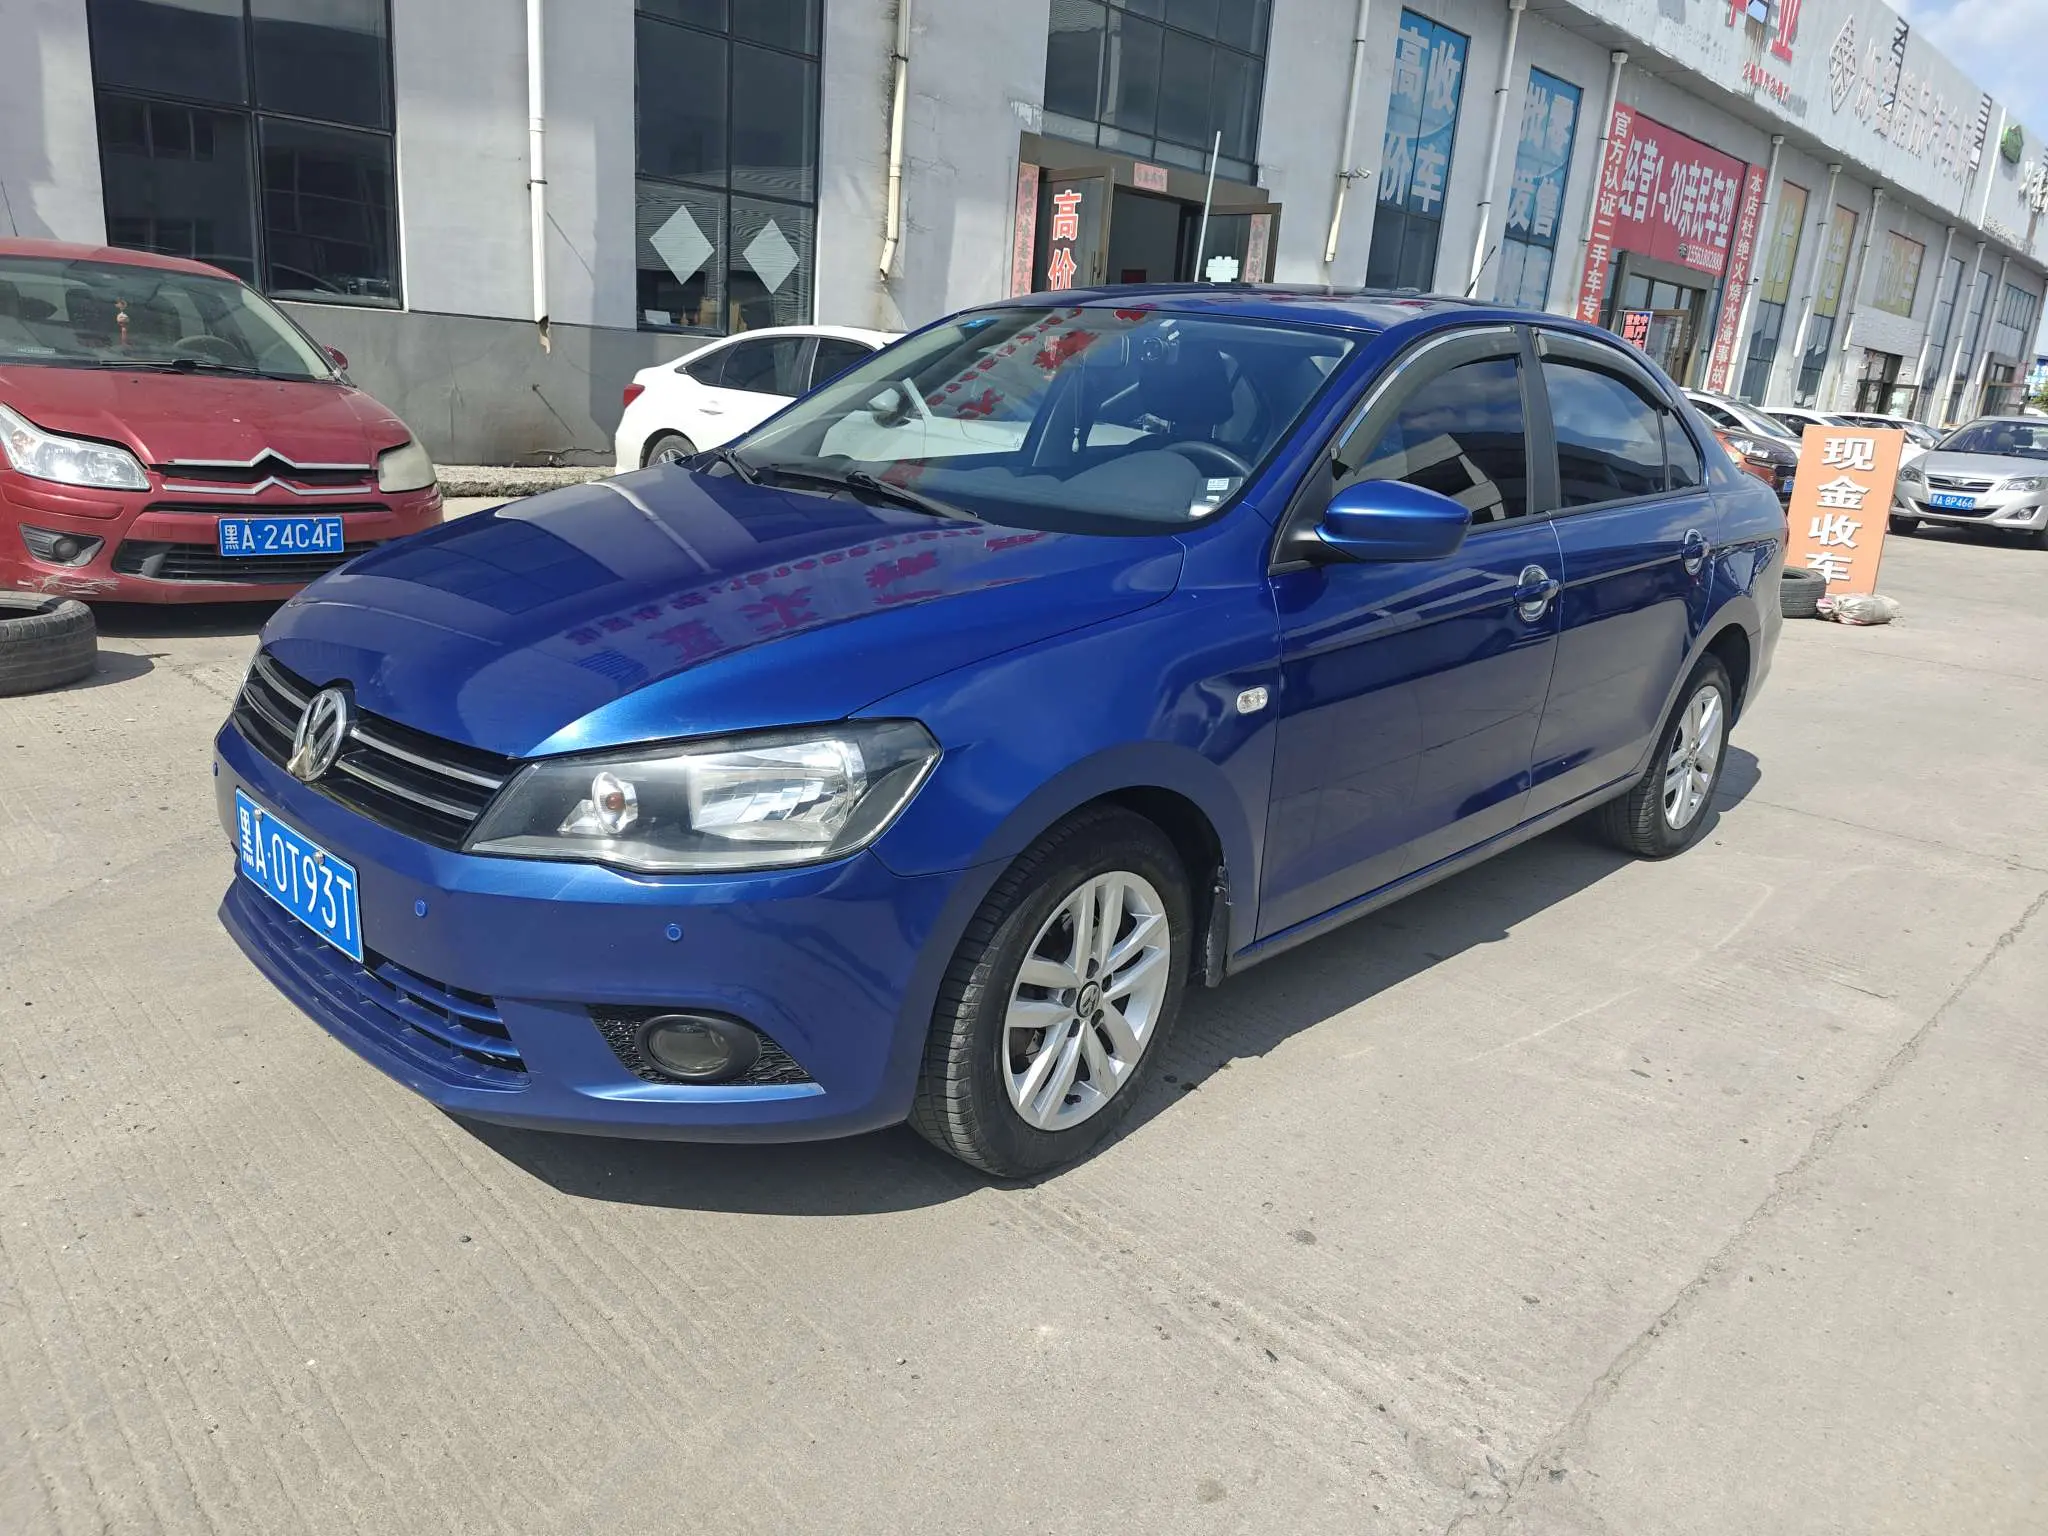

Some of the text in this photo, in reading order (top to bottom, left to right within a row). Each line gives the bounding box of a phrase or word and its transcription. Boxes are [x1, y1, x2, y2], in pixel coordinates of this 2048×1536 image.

[1379, 26, 1429, 205] 高价
[1410, 40, 1462, 213] 收车
[1508, 82, 1549, 232] 批发
[1532, 94, 1574, 238] 零售
[1048, 189, 1082, 291] 高价
[1581, 111, 1632, 325] 官方认证二手车专
[1618, 133, 1738, 248] 经营1-30亲民车型
[1707, 173, 1763, 393] 本店杜绝火烧水淹事故
[223, 523, 340, 550] 黑A·24C4F
[1806, 437, 1875, 584] 现金收车
